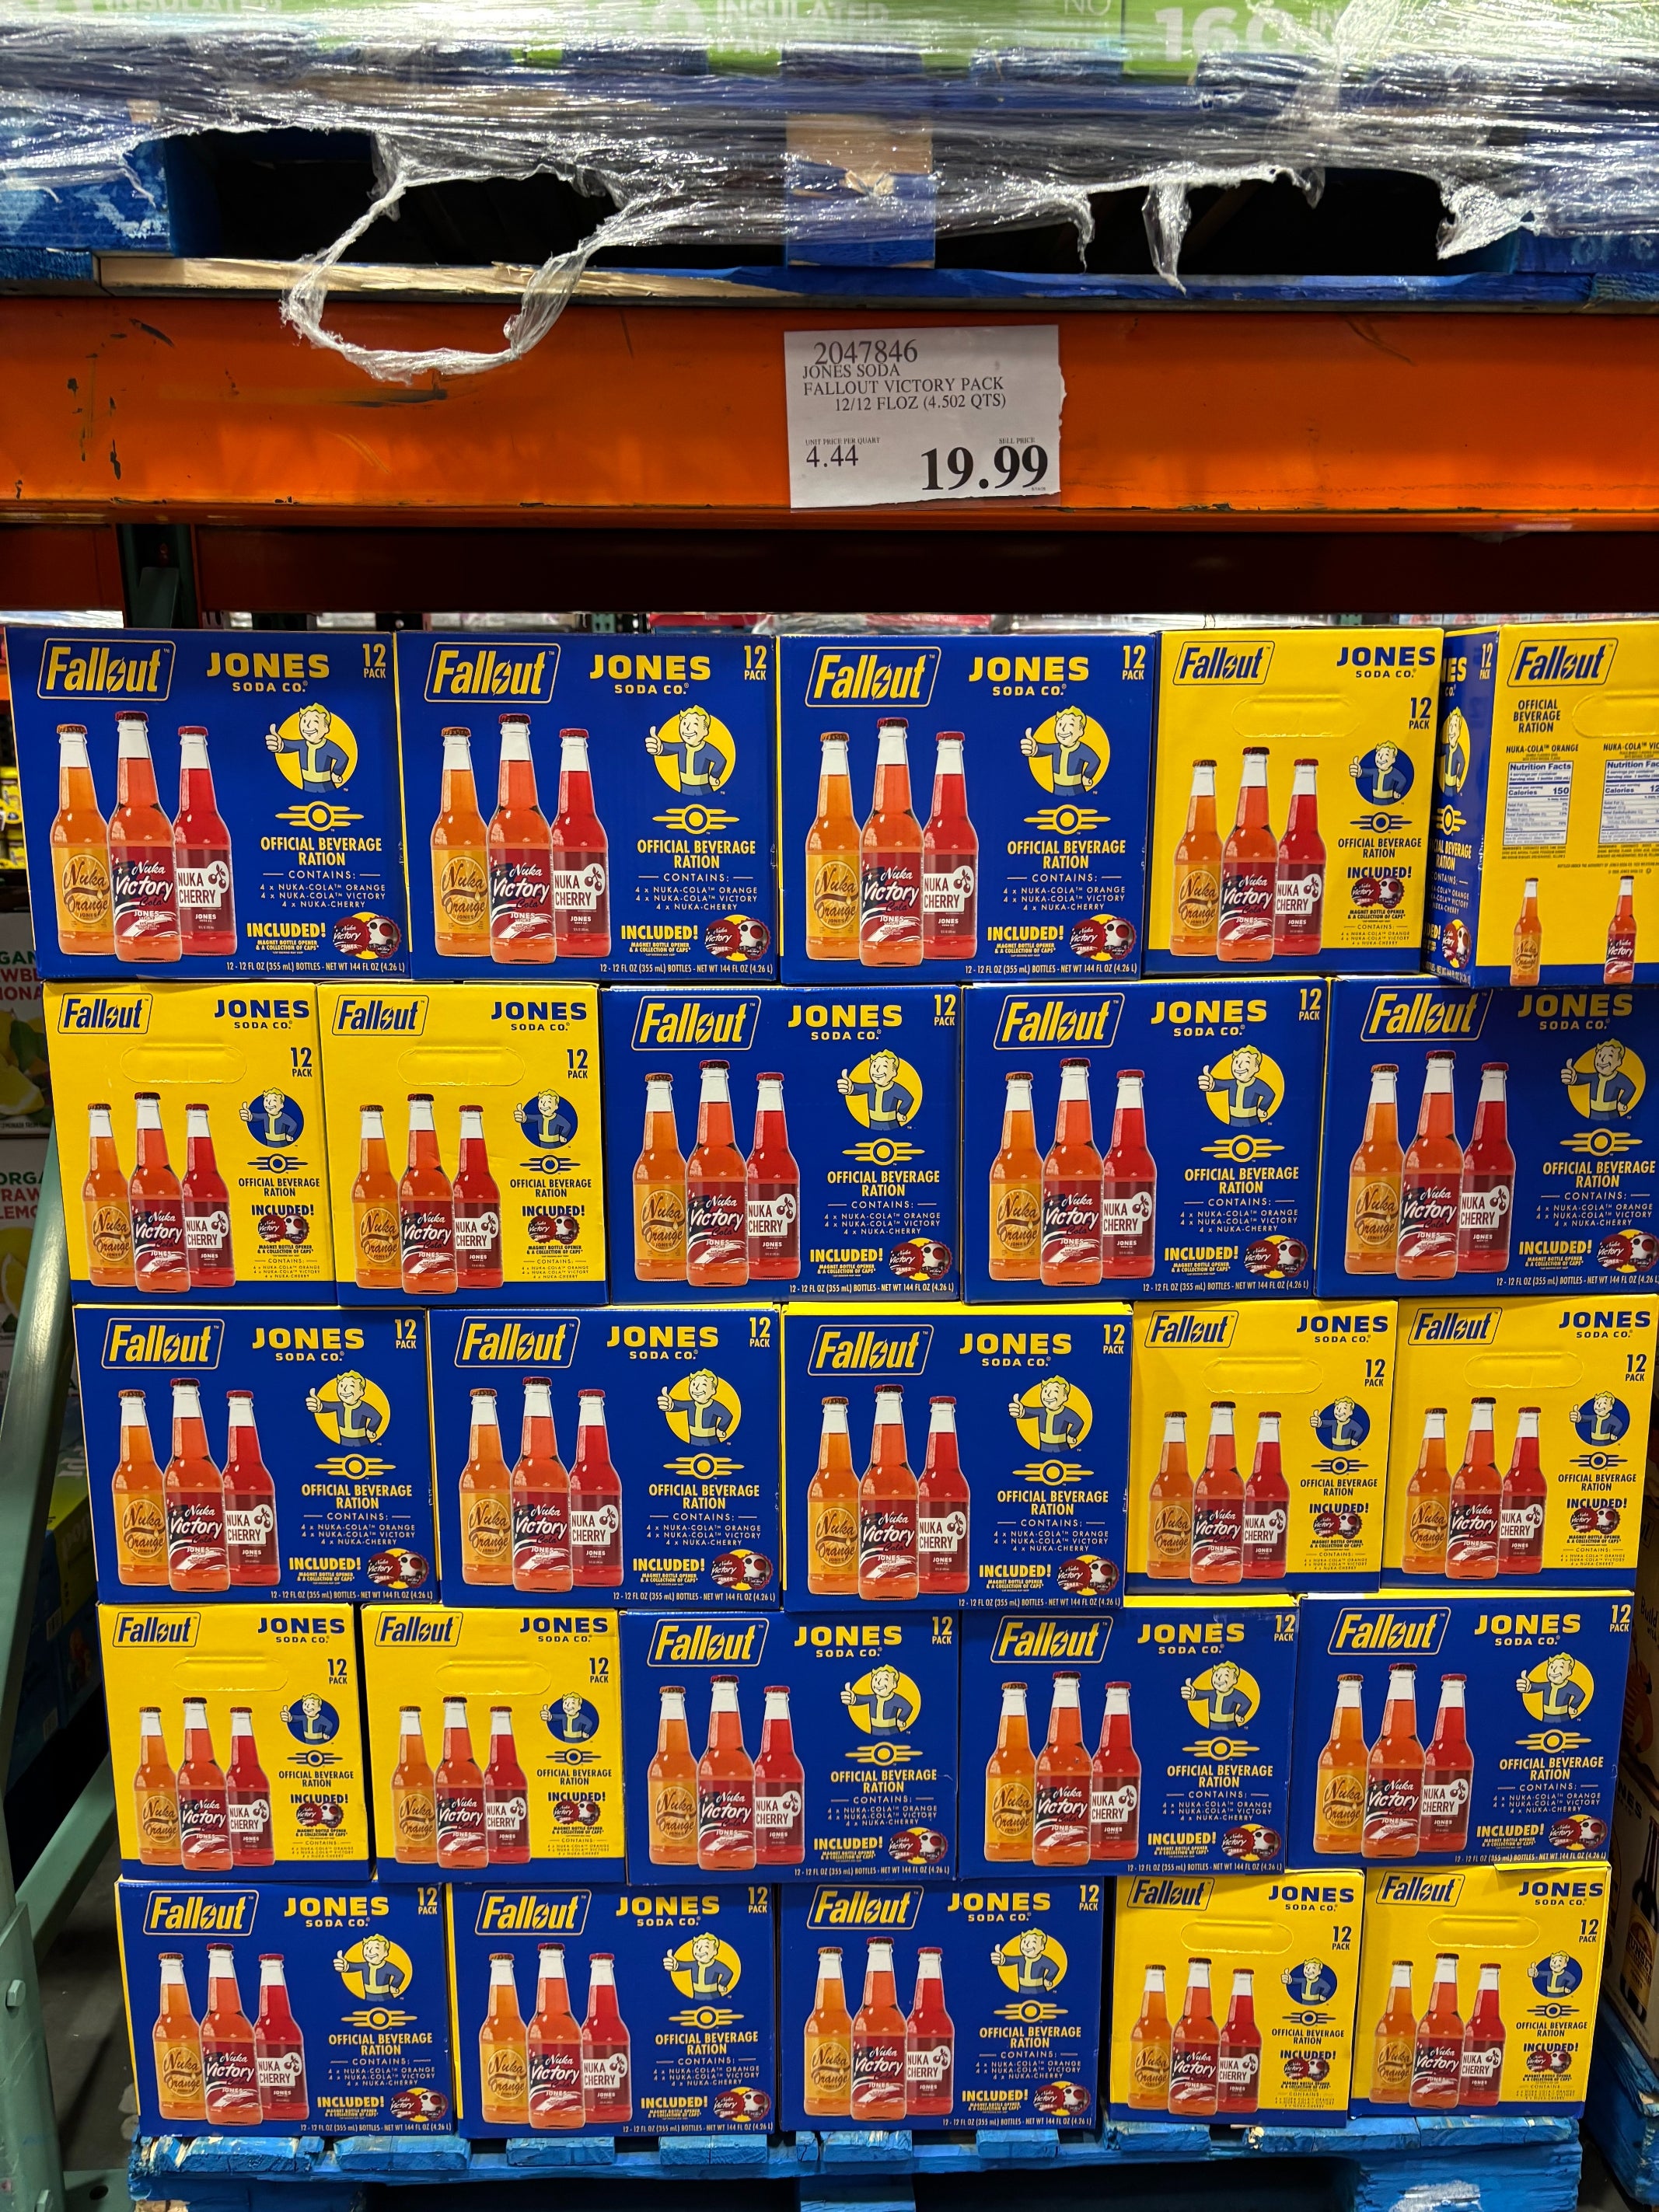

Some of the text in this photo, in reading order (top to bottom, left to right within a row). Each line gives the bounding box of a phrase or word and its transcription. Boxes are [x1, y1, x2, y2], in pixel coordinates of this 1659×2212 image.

[814, 339, 918, 365] 2047846
[802, 363, 900, 379] JONES SODA
[804, 376, 1004, 396] FALLOUT VICTORY PACK
[835, 393, 1007, 411] 12/12 FLOZ (4.502 QTS)
[805, 444, 859, 467] 4.44
[920, 444, 1049, 491] 19.99
[206, 652, 330, 679] JONES
[1179, 647, 1264, 680] Fallout
[1336, 646, 1436, 667] JONES
[1482, 642, 1493, 668] 12
[1514, 644, 1607, 680] Fallout
[46, 646, 160, 693] Fallout
[433, 650, 545, 695] Fallout
[589, 654, 711, 681] JONES
[814, 654, 926, 699] Fallout
[968, 656, 1089, 682] JONES
[1355, 670, 1391, 679] SODA
[1518, 699, 1558, 710] OFFICIAL
[1513, 710, 1561, 722] BEVERAGE
[1518, 722, 1554, 734] RATION
[1551, 744, 1579, 752] ORANGE
[260, 837, 382, 851] OFFICIAL BEVERAGE
[1445, 840, 1472, 860] BEVERAGE
[298, 846, 346, 867] RATION
[288, 870, 355, 880] CONTAINS:
[1086, 885, 1125, 894] ORANGE
[248, 923, 326, 937] INCLUDED!
[600, 964, 608, 972] 12
[613, 964, 620, 973] 12
[621, 964, 628, 973] FL
[630, 964, 637, 973] OZ
[639, 963, 651, 974] (355
[653, 963, 665, 974] mL)
[667, 964, 692, 973] BOTTLES
[697, 964, 709, 973] NET
[709, 964, 718, 973] WT
[720, 964, 731, 973] 144
[732, 964, 739, 973] FL
[740, 964, 749, 973] OZ
[749, 963, 766, 974] (4.26
[767, 963, 773, 974] L)
[63, 998, 142, 1029] Fallout
[214, 1000, 309, 1019] JONES
[337, 1000, 418, 1031] Fallout
[491, 1001, 587, 1021] JONES
[788, 1004, 903, 1028] JONES
[1151, 1000, 1266, 1024] JONES
[1369, 993, 1477, 1034] Fallout
[1518, 993, 1633, 1017] JONES
[639, 1003, 746, 1043] Fallout
[1001, 1001, 1109, 1042] Fallout
[566, 1048, 589, 1076] 12
[568, 1069, 589, 1079] PACK
[1062, 1194, 1094, 1206] Nuka
[1356, 1188, 1398, 1212] Nuka
[749, 1207, 772, 1217] NUKA
[1043, 1206, 1100, 1231] Victory
[749, 1219, 782, 1233] CHERRY
[1150, 1314, 1228, 1344] Fallout
[1296, 1315, 1388, 1334] JONES
[1413, 1312, 1492, 1341] Fallout
[1559, 1310, 1650, 1329] JONES
[252, 1328, 364, 1350] JONES
[394, 1318, 417, 1345] 12
[462, 1323, 566, 1361] Fallout
[606, 1326, 718, 1348] JONES
[109, 1324, 211, 1362] Fallout
[395, 1339, 416, 1348] PACK
[816, 1331, 920, 1369] Fallout
[959, 1333, 1072, 1355] JONES
[1558, 1474, 1637, 1482] OFFICIAL BEVERAGE
[1323, 1488, 1354, 1496] RATION
[117, 1616, 191, 1643] Fallout
[257, 1617, 345, 1635] JONES
[379, 1616, 453, 1642] Fallout
[519, 1617, 608, 1635] JONES
[1137, 1623, 1245, 1644] JONES
[1336, 1614, 1437, 1649] Fallout
[1474, 1614, 1580, 1635] JONES
[655, 1625, 755, 1661] Fallout
[794, 1625, 902, 1647] JONES
[998, 1622, 1098, 1657] Fallout
[1477, 1824, 1545, 1837] INCLUDED!
[1132, 1878, 1205, 1907] Fallout
[1268, 1885, 1354, 1904] JONES
[1381, 1875, 1455, 1903] Fallout
[1518, 1881, 1604, 1898] JONES
[150, 1896, 245, 1930] Fallout
[284, 1896, 389, 1917] JONES
[482, 1896, 578, 1930] Fallout
[616, 1896, 720, 1917] JONES
[814, 1891, 910, 1924] Fallout
[948, 1893, 1050, 1912] JONES
[1579, 1920, 1600, 1936] 12
